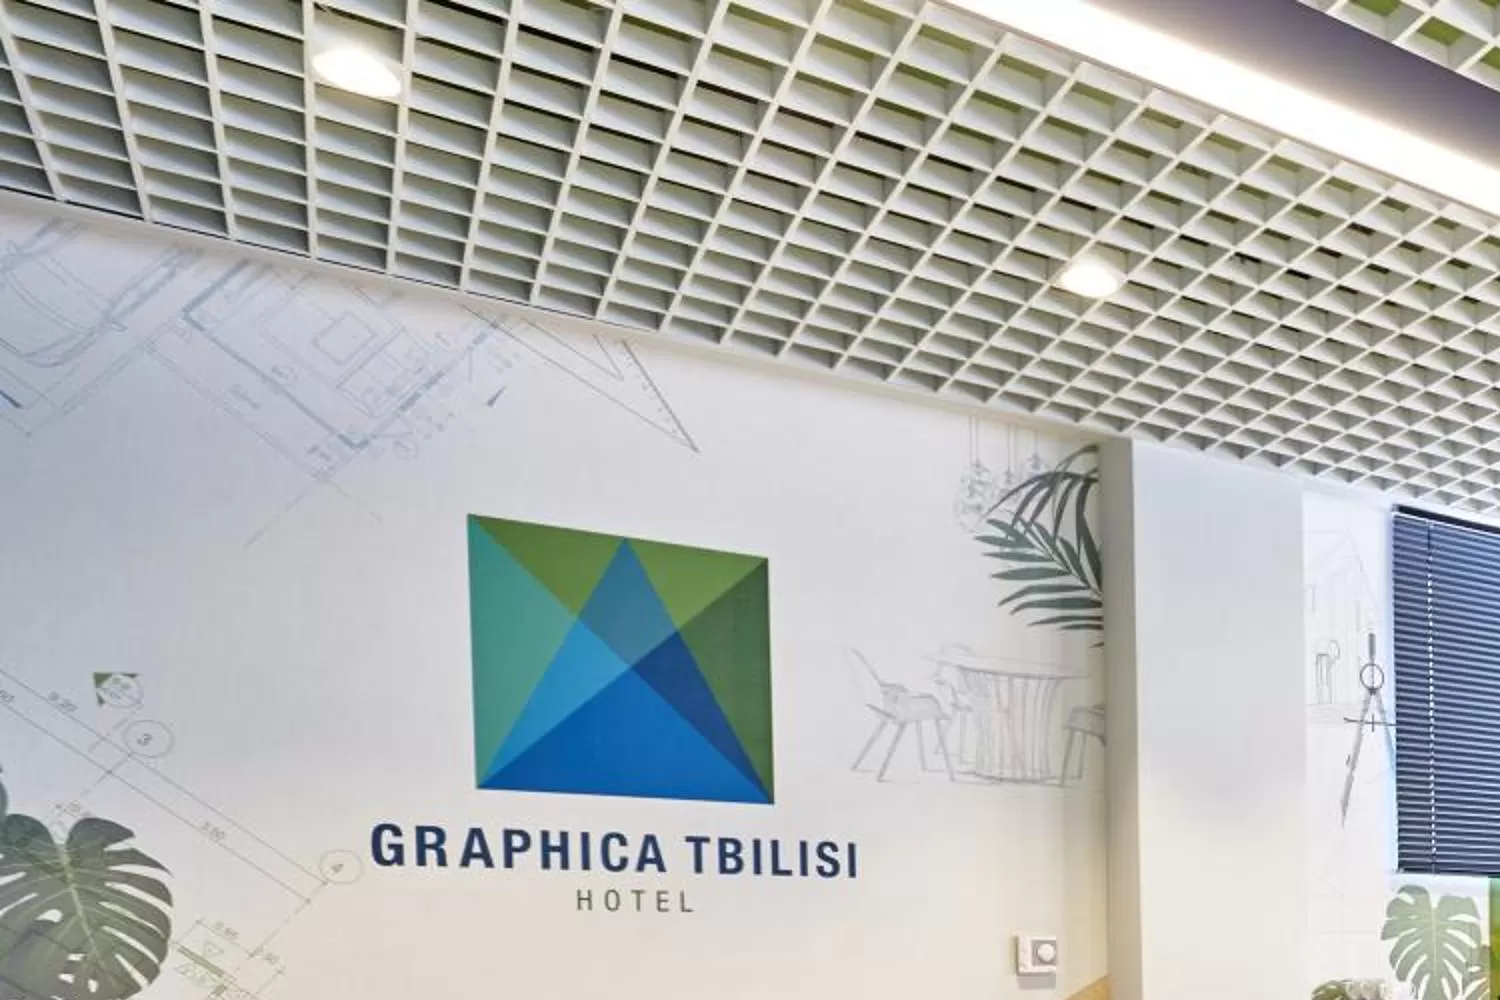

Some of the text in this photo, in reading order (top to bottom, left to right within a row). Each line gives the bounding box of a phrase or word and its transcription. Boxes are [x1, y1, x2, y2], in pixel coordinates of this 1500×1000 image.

[371, 823, 857, 878] GRAPHICA TBILISI
[576, 888, 694, 913] HOTEL
